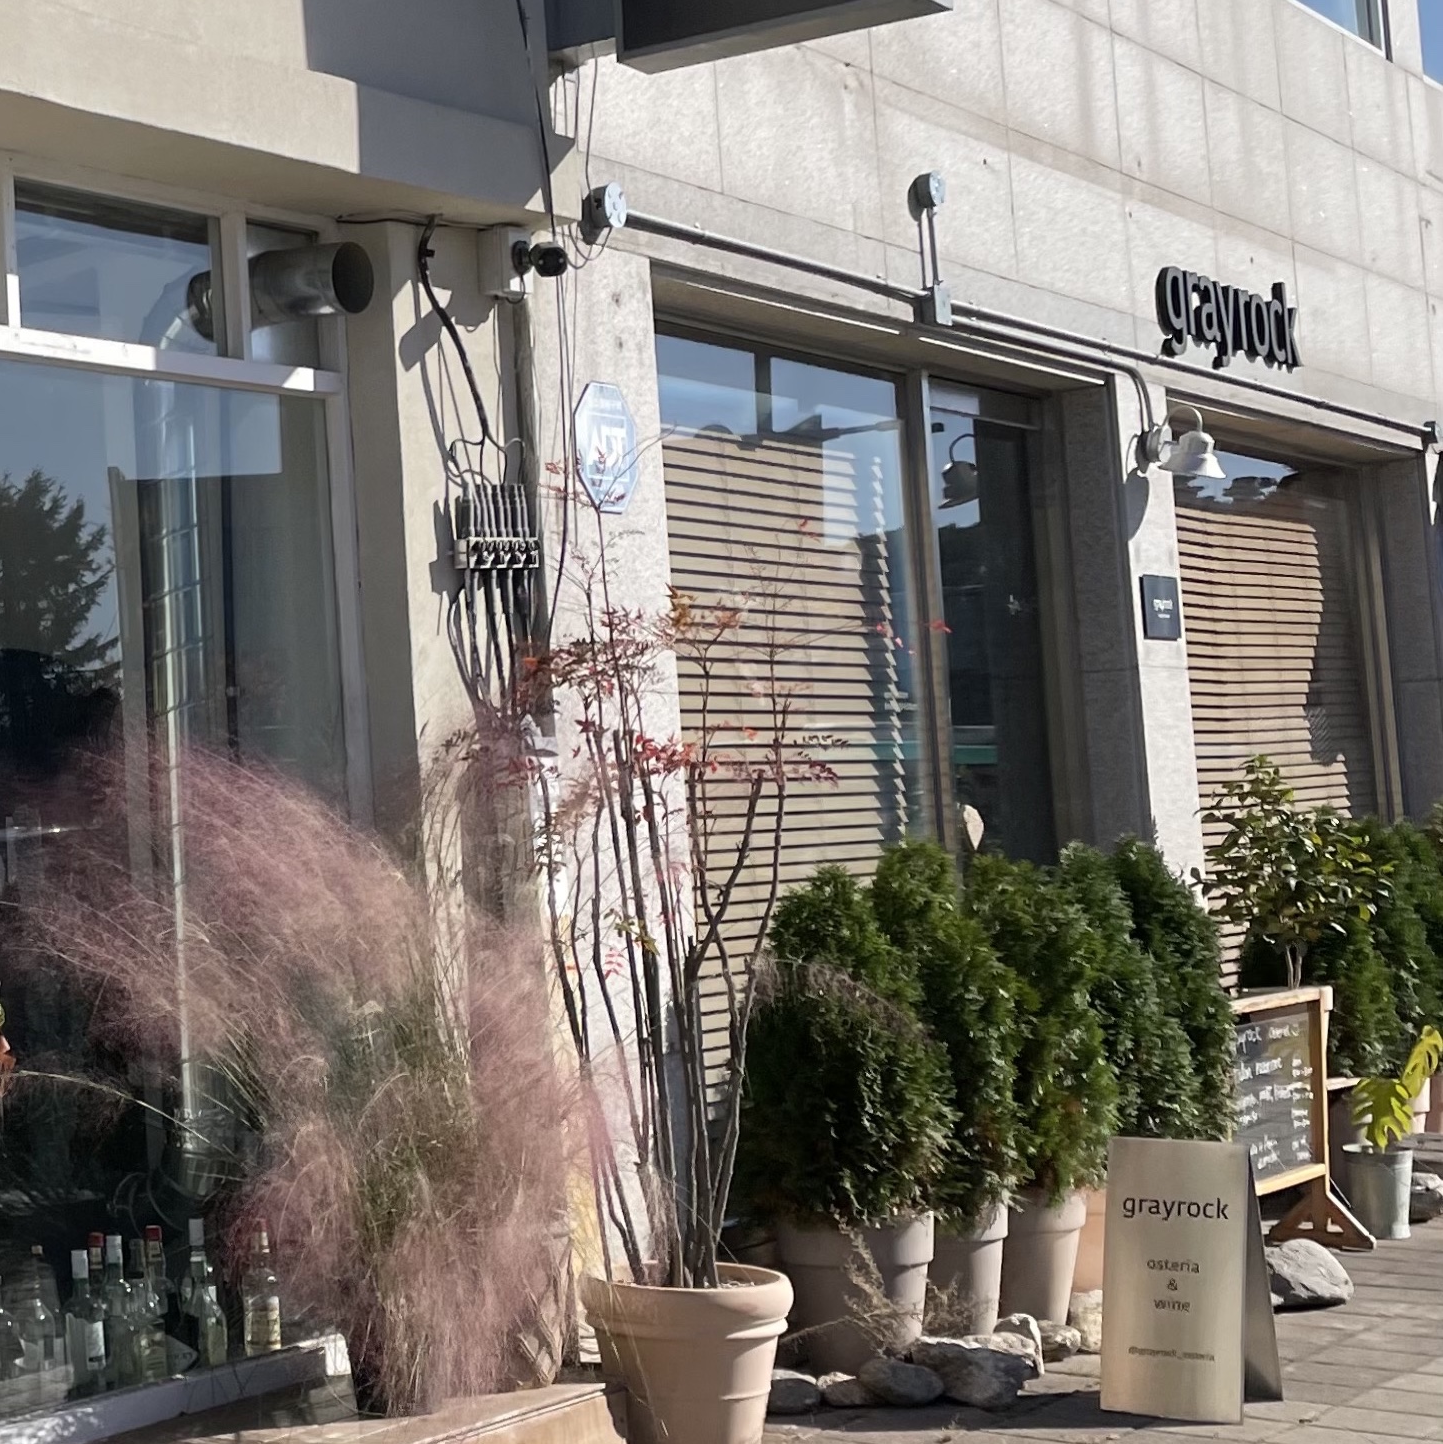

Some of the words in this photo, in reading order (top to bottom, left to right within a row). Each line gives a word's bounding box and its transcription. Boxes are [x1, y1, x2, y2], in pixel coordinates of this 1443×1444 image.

[1156, 266, 1303, 374] grayrock
[587, 425, 627, 471] ADT
[1123, 1197, 1229, 1221] grayrock
[1147, 1258, 1200, 1274] osteria
[1166, 1278, 1178, 1291] &
[1153, 1298, 1191, 1313] wine
